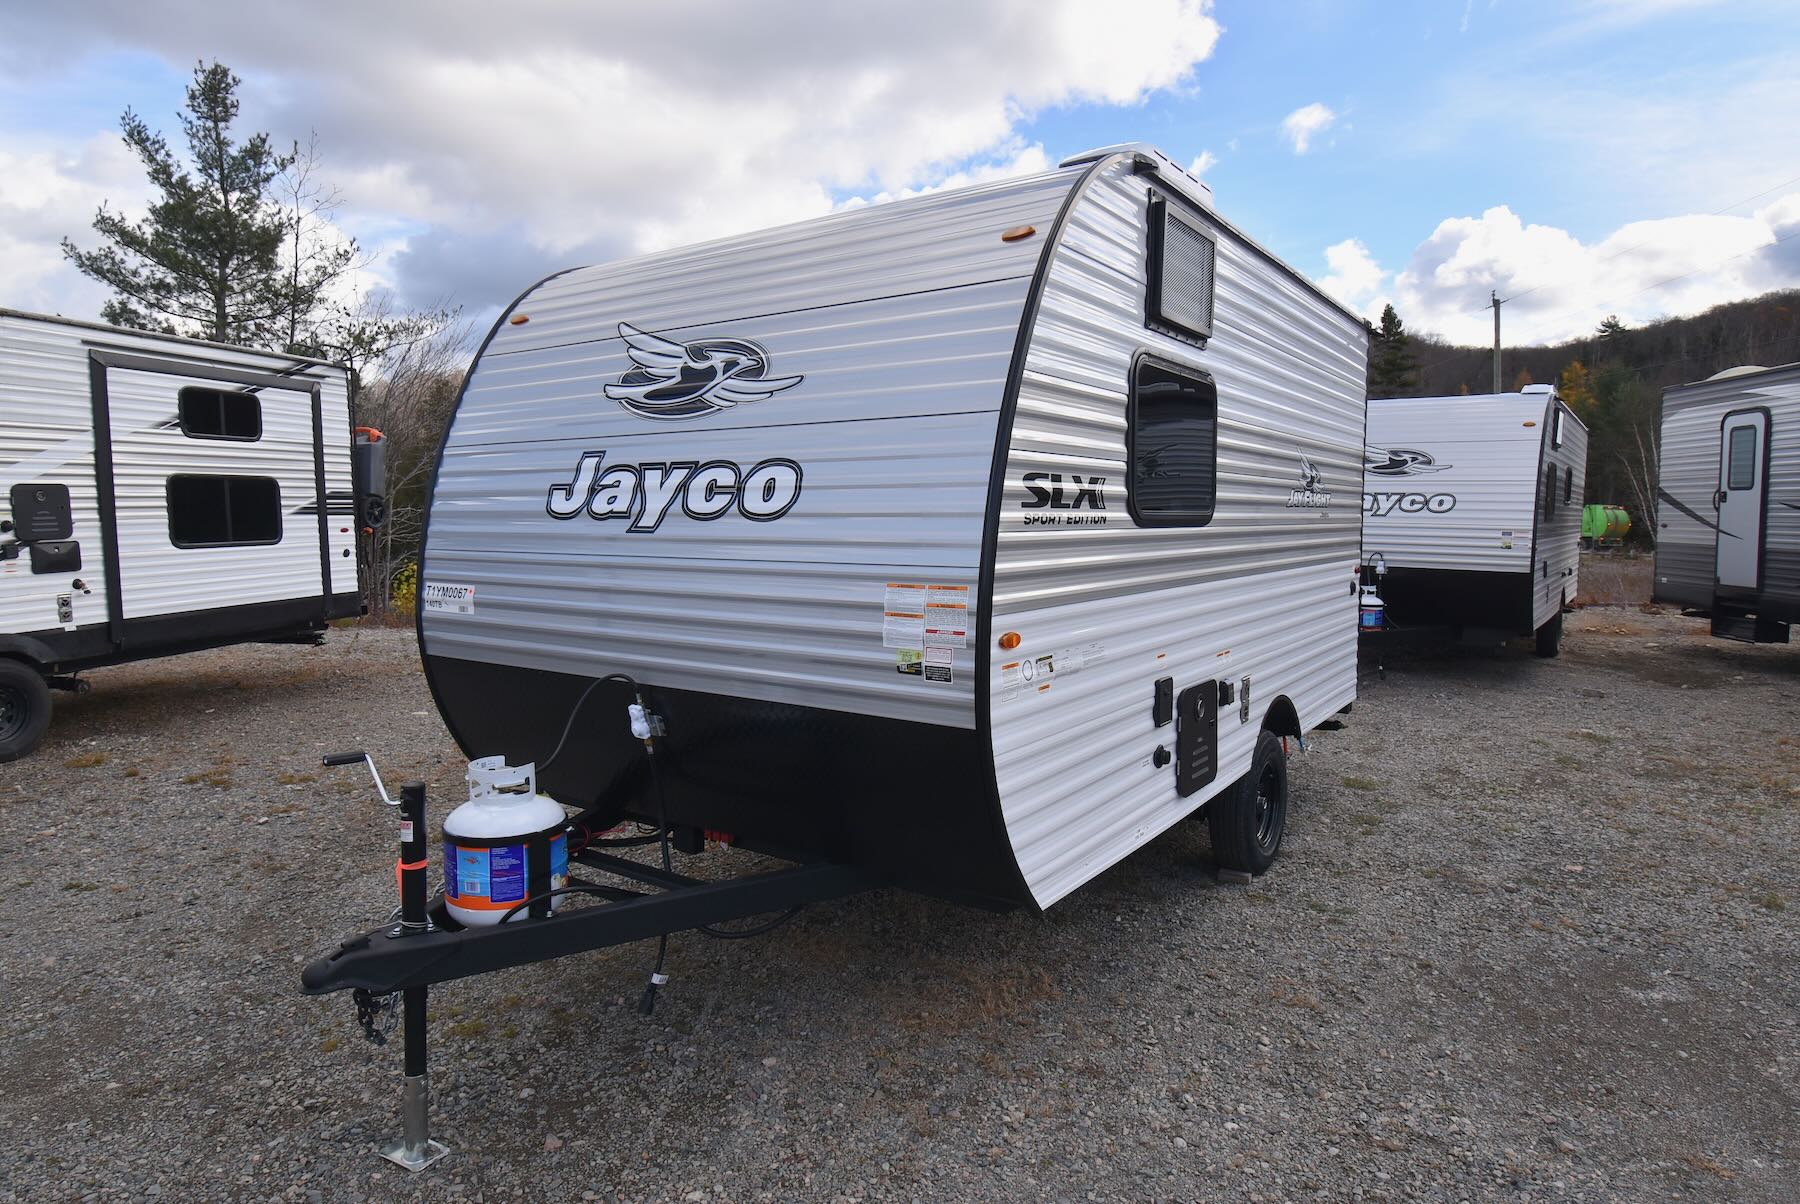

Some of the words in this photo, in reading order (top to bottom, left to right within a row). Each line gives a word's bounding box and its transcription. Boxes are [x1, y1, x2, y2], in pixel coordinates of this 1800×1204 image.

[546, 450, 804, 533] Jayco
[1021, 472, 1106, 509] SLX
[1024, 512, 1063, 525] SPORT
[1066, 514, 1107, 525] EDITION
